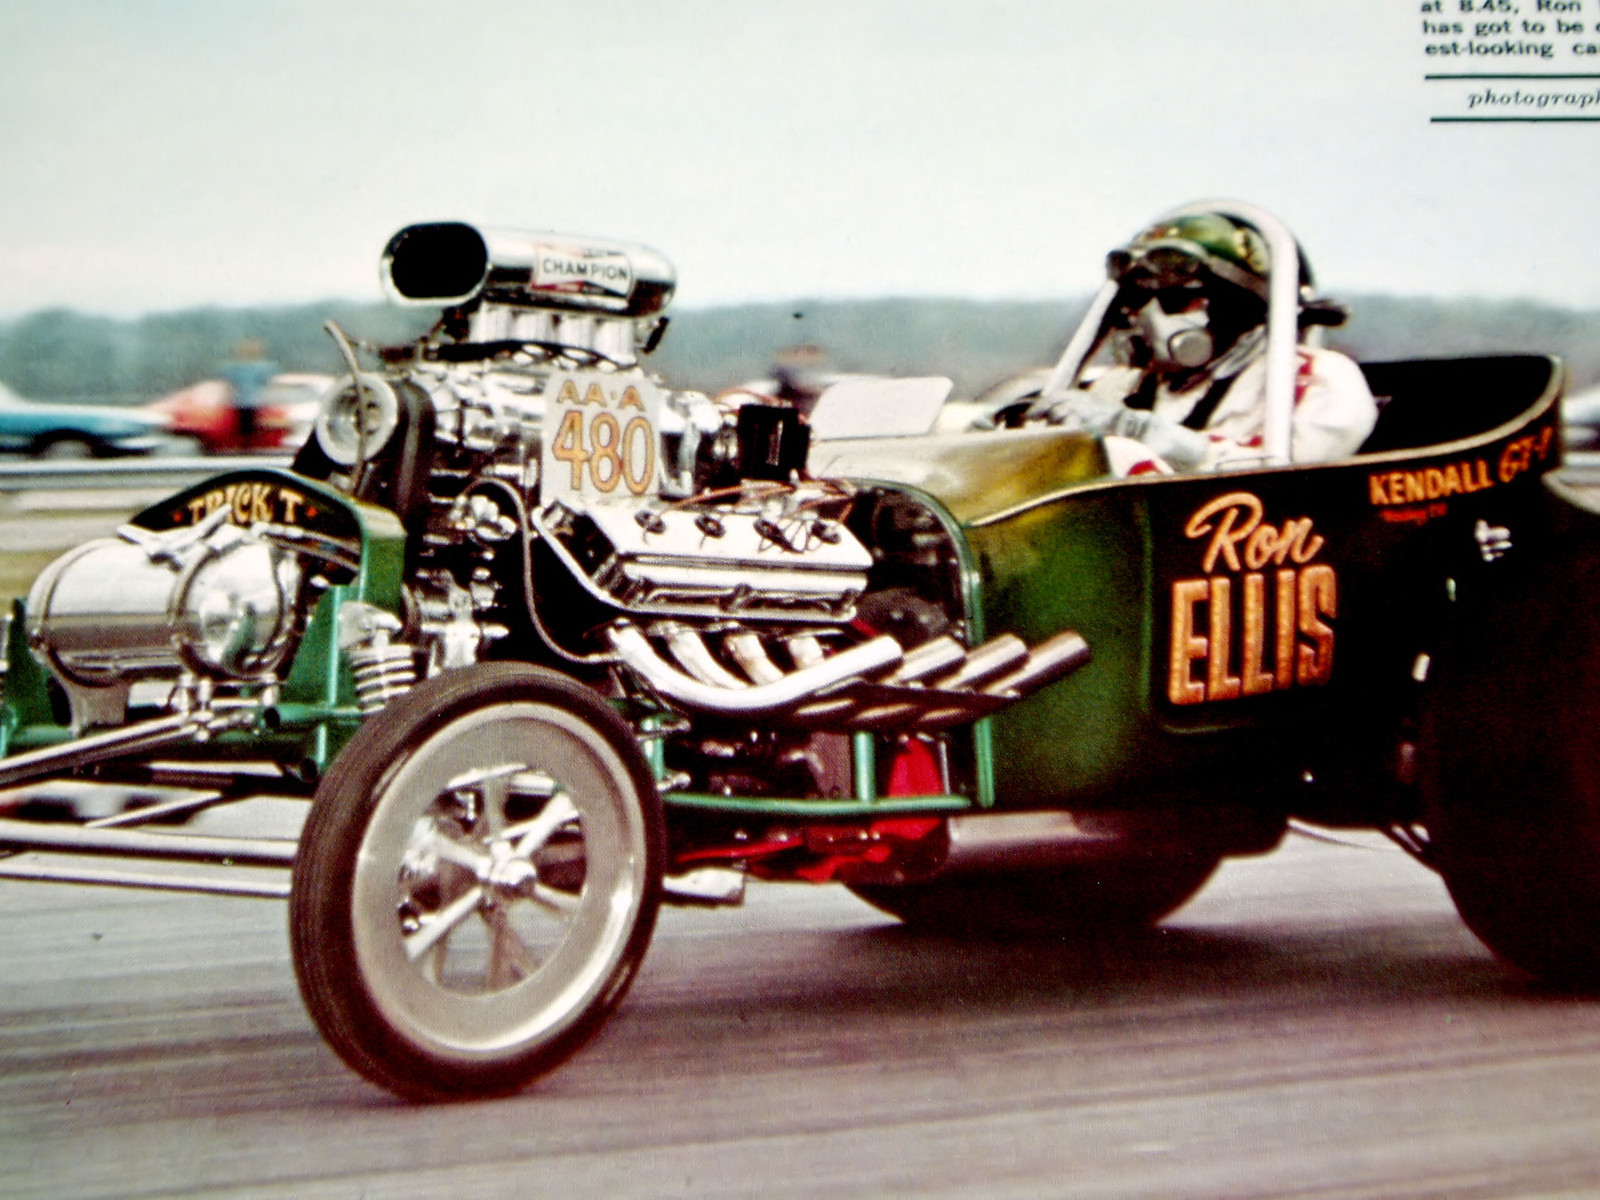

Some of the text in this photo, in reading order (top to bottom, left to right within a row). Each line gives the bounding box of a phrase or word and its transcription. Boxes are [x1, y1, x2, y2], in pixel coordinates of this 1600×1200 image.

[1421, 0, 1442, 12] at
[1536, 0, 1581, 12] Ron
[1423, 20, 1463, 34] has
[1475, 20, 1511, 36] got
[1522, 20, 1545, 33] to
[1557, 19, 1584, 33] be
[1425, 41, 1600, 58] est-looking ca
[543, 258, 627, 281] CHAMPION
[552, 410, 654, 496] 480
[1369, 458, 1495, 505] KENDALL
[279, 489, 303, 524] T
[1185, 491, 1325, 573] Ron
[1169, 564, 1338, 706] ELLIS
